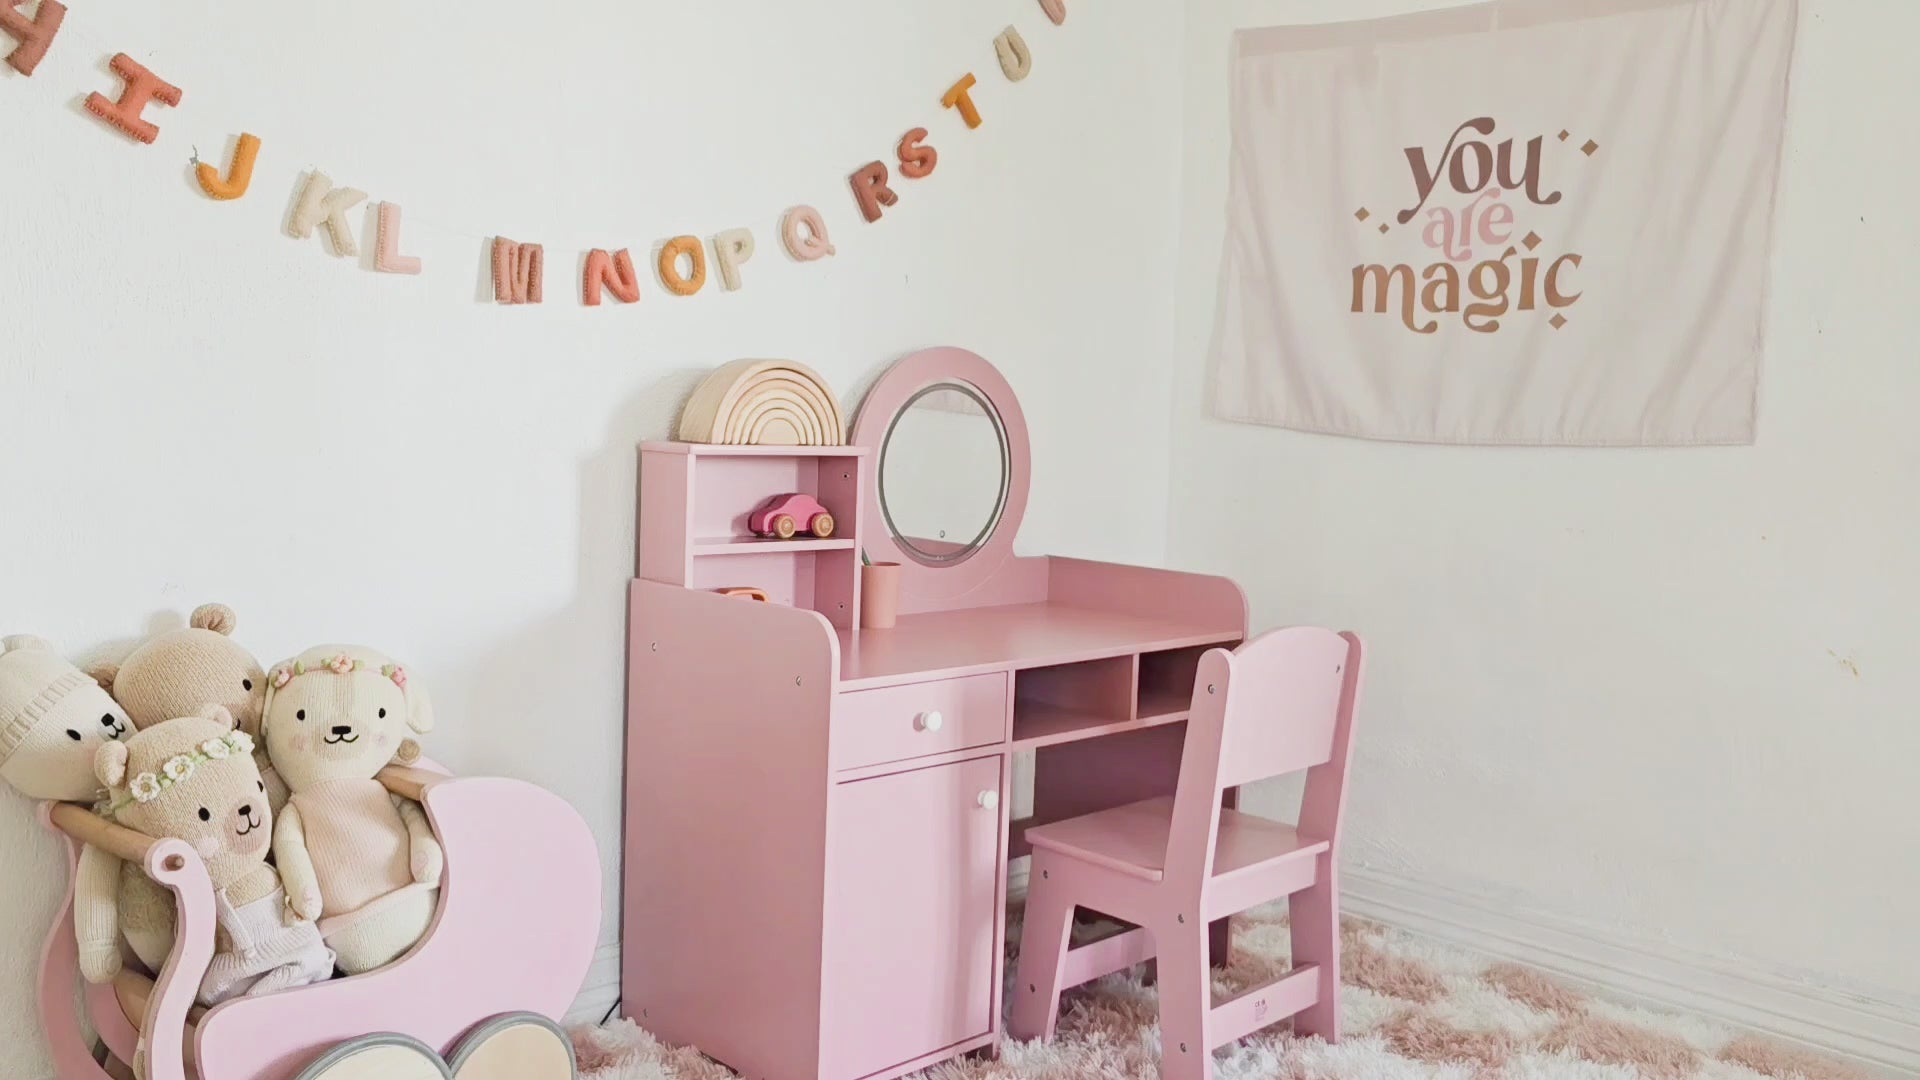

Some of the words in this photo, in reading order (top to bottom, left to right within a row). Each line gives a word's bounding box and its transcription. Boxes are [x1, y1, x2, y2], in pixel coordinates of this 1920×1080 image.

[84, 52, 182, 144] I
[195, 132, 261, 200] J
[287, 168, 368, 257] K
[376, 200, 422, 275] L
[491, 235, 544, 304] M
[583, 248, 640, 305] N
[658, 235, 706, 296] O
[713, 227, 755, 291] P
[782, 205, 836, 262] Q
[848, 160, 898, 223] R
[896, 127, 938, 178] S
[940, 72, 982, 129] T
[1397, 116, 1562, 224] you
[1422, 187, 1514, 262] are
[1350, 230, 1583, 334] magic
